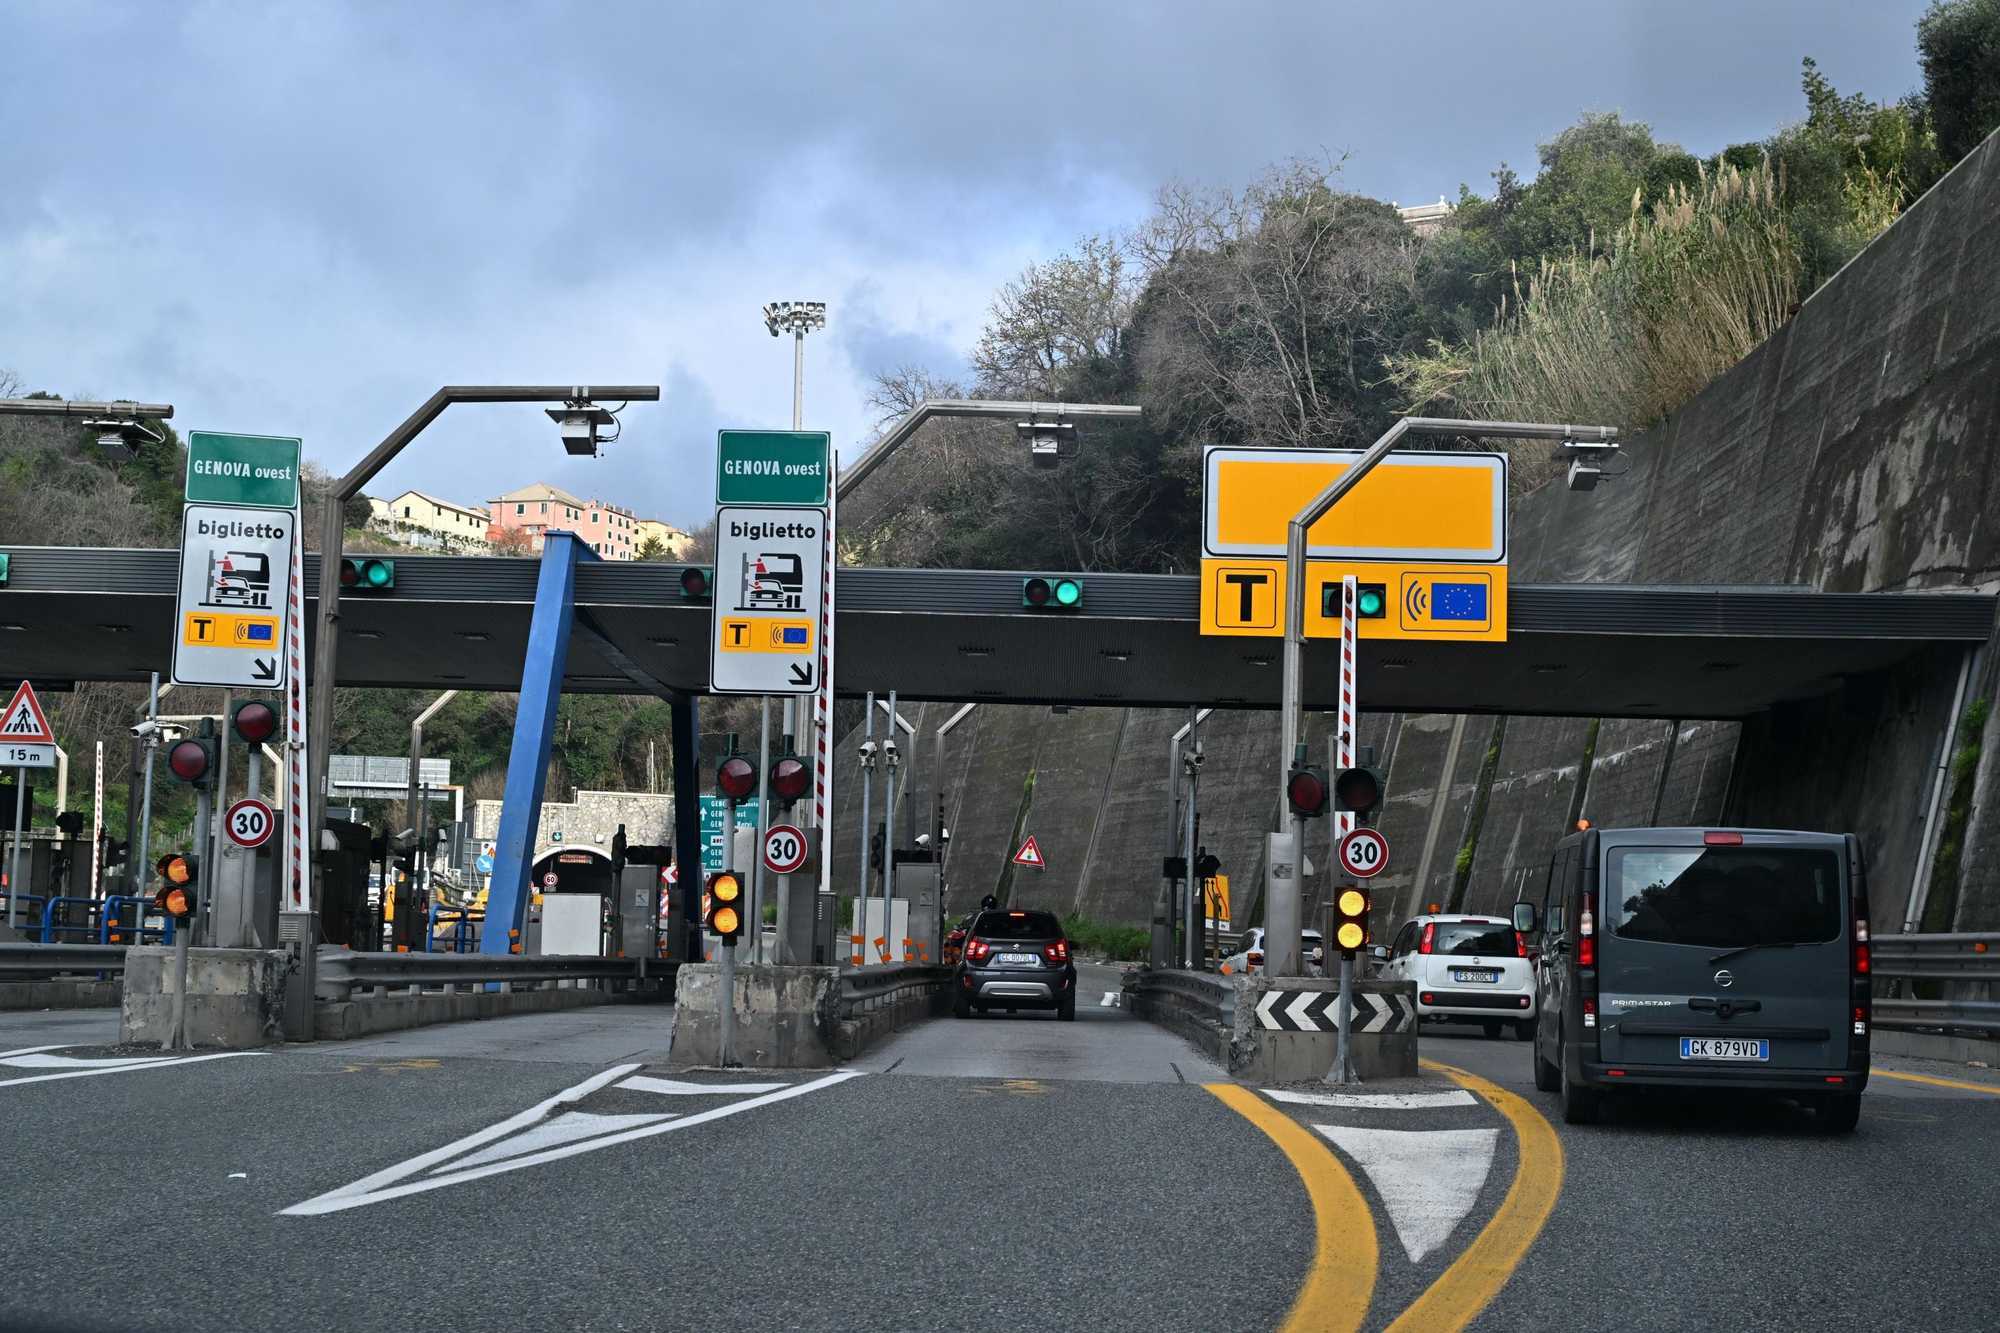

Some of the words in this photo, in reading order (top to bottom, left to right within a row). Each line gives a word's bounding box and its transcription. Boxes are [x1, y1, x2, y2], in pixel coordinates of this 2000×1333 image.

[194, 460, 251, 478] GENOVA
[255, 465, 292, 480] ovest
[724, 460, 780, 476] GENOVA
[784, 461, 821, 476] ovest
[198, 519, 285, 539] biglietto
[730, 521, 816, 540] biglietto
[1226, 574, 1268, 622] T
[193, 619, 212, 640] T
[729, 624, 748, 645] T
[9, 749, 27, 761] 15
[29, 753, 40, 761] m
[236, 812, 263, 835] 30
[770, 838, 797, 860] 30
[1351, 841, 1378, 864] 30
[1611, 999, 1672, 1007] PRIMASTAR
[1691, 1040, 1709, 1055] GK
[1714, 1041, 1759, 1057] 879VD
